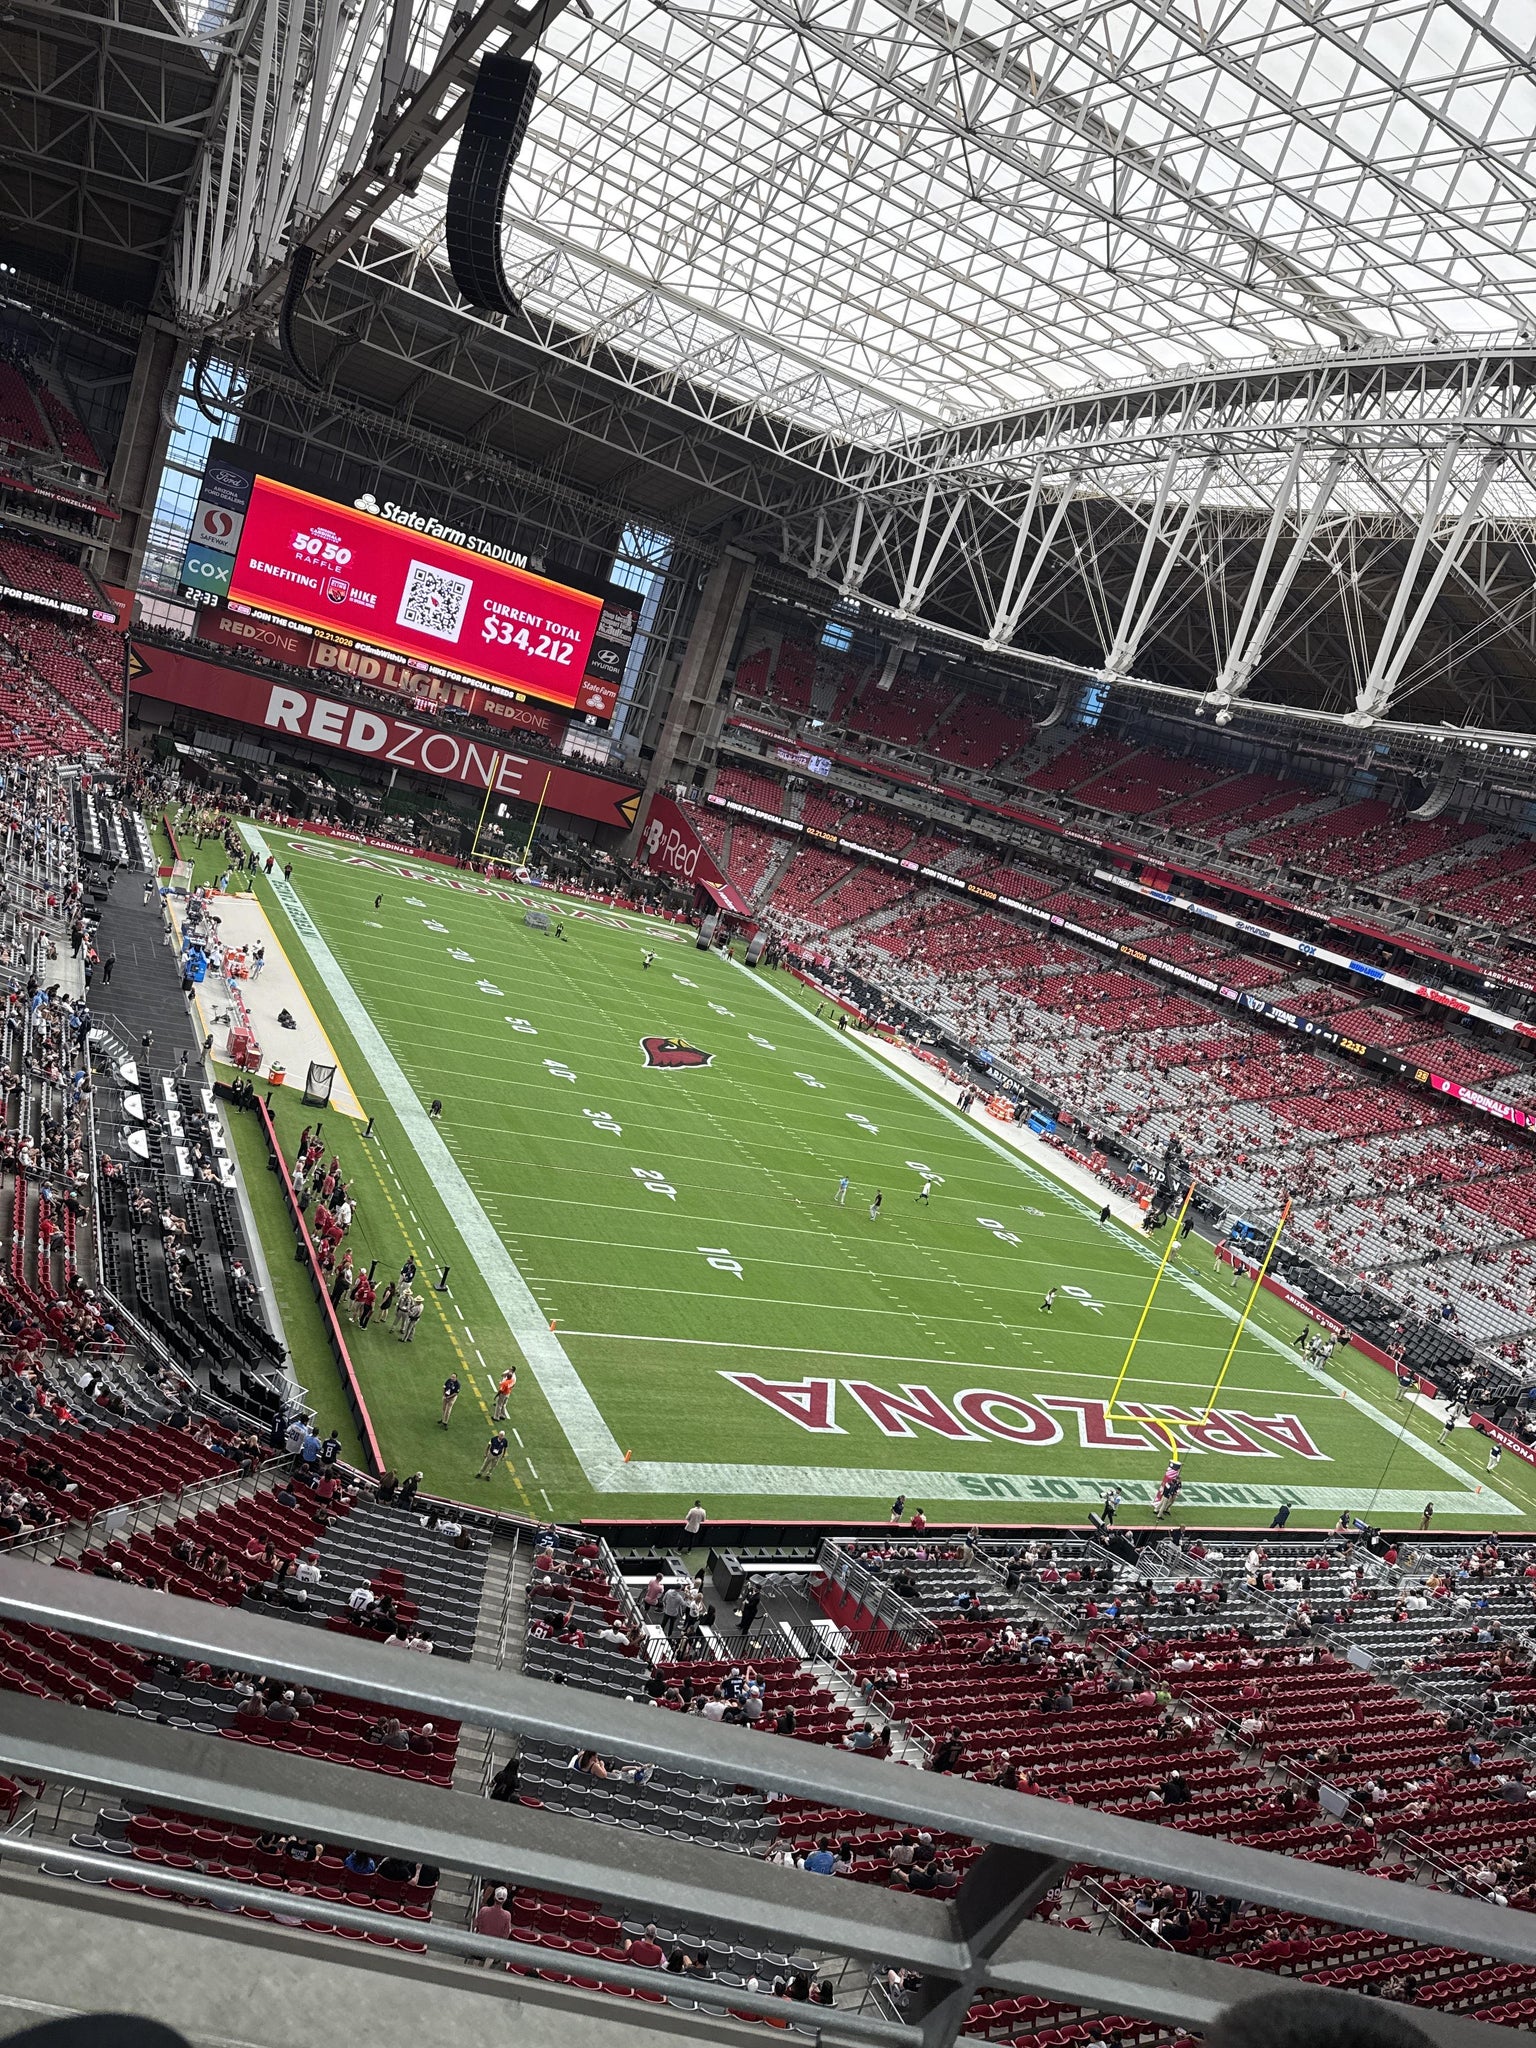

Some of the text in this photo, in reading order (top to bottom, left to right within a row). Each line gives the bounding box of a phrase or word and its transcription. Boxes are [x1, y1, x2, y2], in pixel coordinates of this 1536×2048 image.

[215, 469, 241, 487] Ford
[34, 487, 97, 512] JIMMY CONZELMAN
[204, 488, 245, 506] FORD DEALERS
[213, 486, 239, 498] ARIZONA
[200, 533, 229, 547] SAFEWAY
[292, 532, 323, 555] 50
[321, 542, 352, 565] 50
[295, 552, 343, 573] RAFFLE
[466, 535, 528, 569] STADIUM
[188, 559, 229, 582] COX
[249, 558, 318, 590] BENEFITING
[3, 587, 89, 616] FOR SPECIAL NEEDS
[185, 587, 219, 607] 22:33
[349, 587, 378, 605] HIKE
[483, 599, 543, 628] CURRENT
[545, 619, 582, 642] TOTAL
[481, 614, 574, 666] $34,212
[251, 610, 271, 623] JOIN
[271, 615, 288, 628] THE
[288, 619, 313, 635] CLIMB
[314, 629, 354, 647] 02.21.2026
[354, 642, 407, 665] #ClimbWithUs
[428, 665, 447, 678] HIKE
[447, 670, 462, 683] FOR
[461, 675, 491, 691] SPECIAL
[490, 684, 515, 699] NEEDS
[315, 642, 471, 707] BUD LIGHT
[591, 660, 621, 675] HYUNDAI
[584, 714, 597, 726] 25
[739, 722, 753, 730] JOHN
[773, 733, 797, 745] DRISCOLL
[928, 784, 945, 793] GREEN
[330, 829, 414, 855] ARIZONA CARDINALS
[1064, 829, 1103, 846] CARSON PALMER
[662, 828, 702, 878] Red
[287, 842, 688, 943] CARDINALS
[726, 801, 742, 812] HIKE
[742, 805, 756, 816] FOR
[756, 808, 783, 824] SPECIAL
[782, 818, 804, 831] NEEDS
[806, 827, 838, 843] 02.21.2026
[839, 838, 899, 865] CardinalsClimb.com
[920, 867, 937, 878] JOIN
[937, 872, 948, 882] THE
[947, 875, 966, 889] CLIMB
[967, 884, 998, 900] 02.21.2026
[998, 895, 1033, 914] CARDINALS
[1032, 908, 1051, 921] CLIMB
[1120, 945, 1148, 961] 02.21.2026
[1148, 956, 1163, 968] HIKE
[1162, 961, 1175, 974] FOR
[1174, 965, 1198, 984] SPECIAL
[1198, 975, 1219, 992] NEEDS
[1293, 904, 1305, 914] DAN
[1304, 907, 1332, 921] DIERDORF
[1244, 924, 1271, 939] HYUNDAI
[1298, 943, 1317, 956] COX
[1349, 961, 1384, 980] BUD LIGHT
[1483, 969, 1506, 982] LARRY
[1507, 975, 1535, 991] WILSON
[504, 1016, 539, 1035] 50
[1271, 1006, 1297, 1023] TITANS
[1305, 1022, 1314, 1033] 0
[1339, 1037, 1367, 1055] 22:33
[542, 1058, 578, 1080] 40
[1441, 1081, 1450, 1092] 0
[1458, 1087, 1510, 1116] CARDINALS
[582, 1108, 623, 1132] 30
[845, 1112, 880, 1134] 40
[630, 1167, 678, 1195] 20
[905, 1160, 946, 1184] 30
[975, 1217, 1023, 1244] 20
[696, 1246, 744, 1273] 10
[1060, 1284, 1106, 1309] 10
[1284, 1293, 1314, 1316] ARIZONA
[715, 1369, 1335, 1461] ARIZONA
[325, 1446, 333, 1458] 8
[957, 1475, 1022, 1500] US
[1022, 1478, 1079, 1500] OF
[1077, 1480, 1157, 1501] ALL
[1267, 1488, 1309, 1506] IT
[352, 1595, 367, 1609] 17
[534, 1626, 548, 1639] 81
[1046, 1888, 1061, 1901] 99
